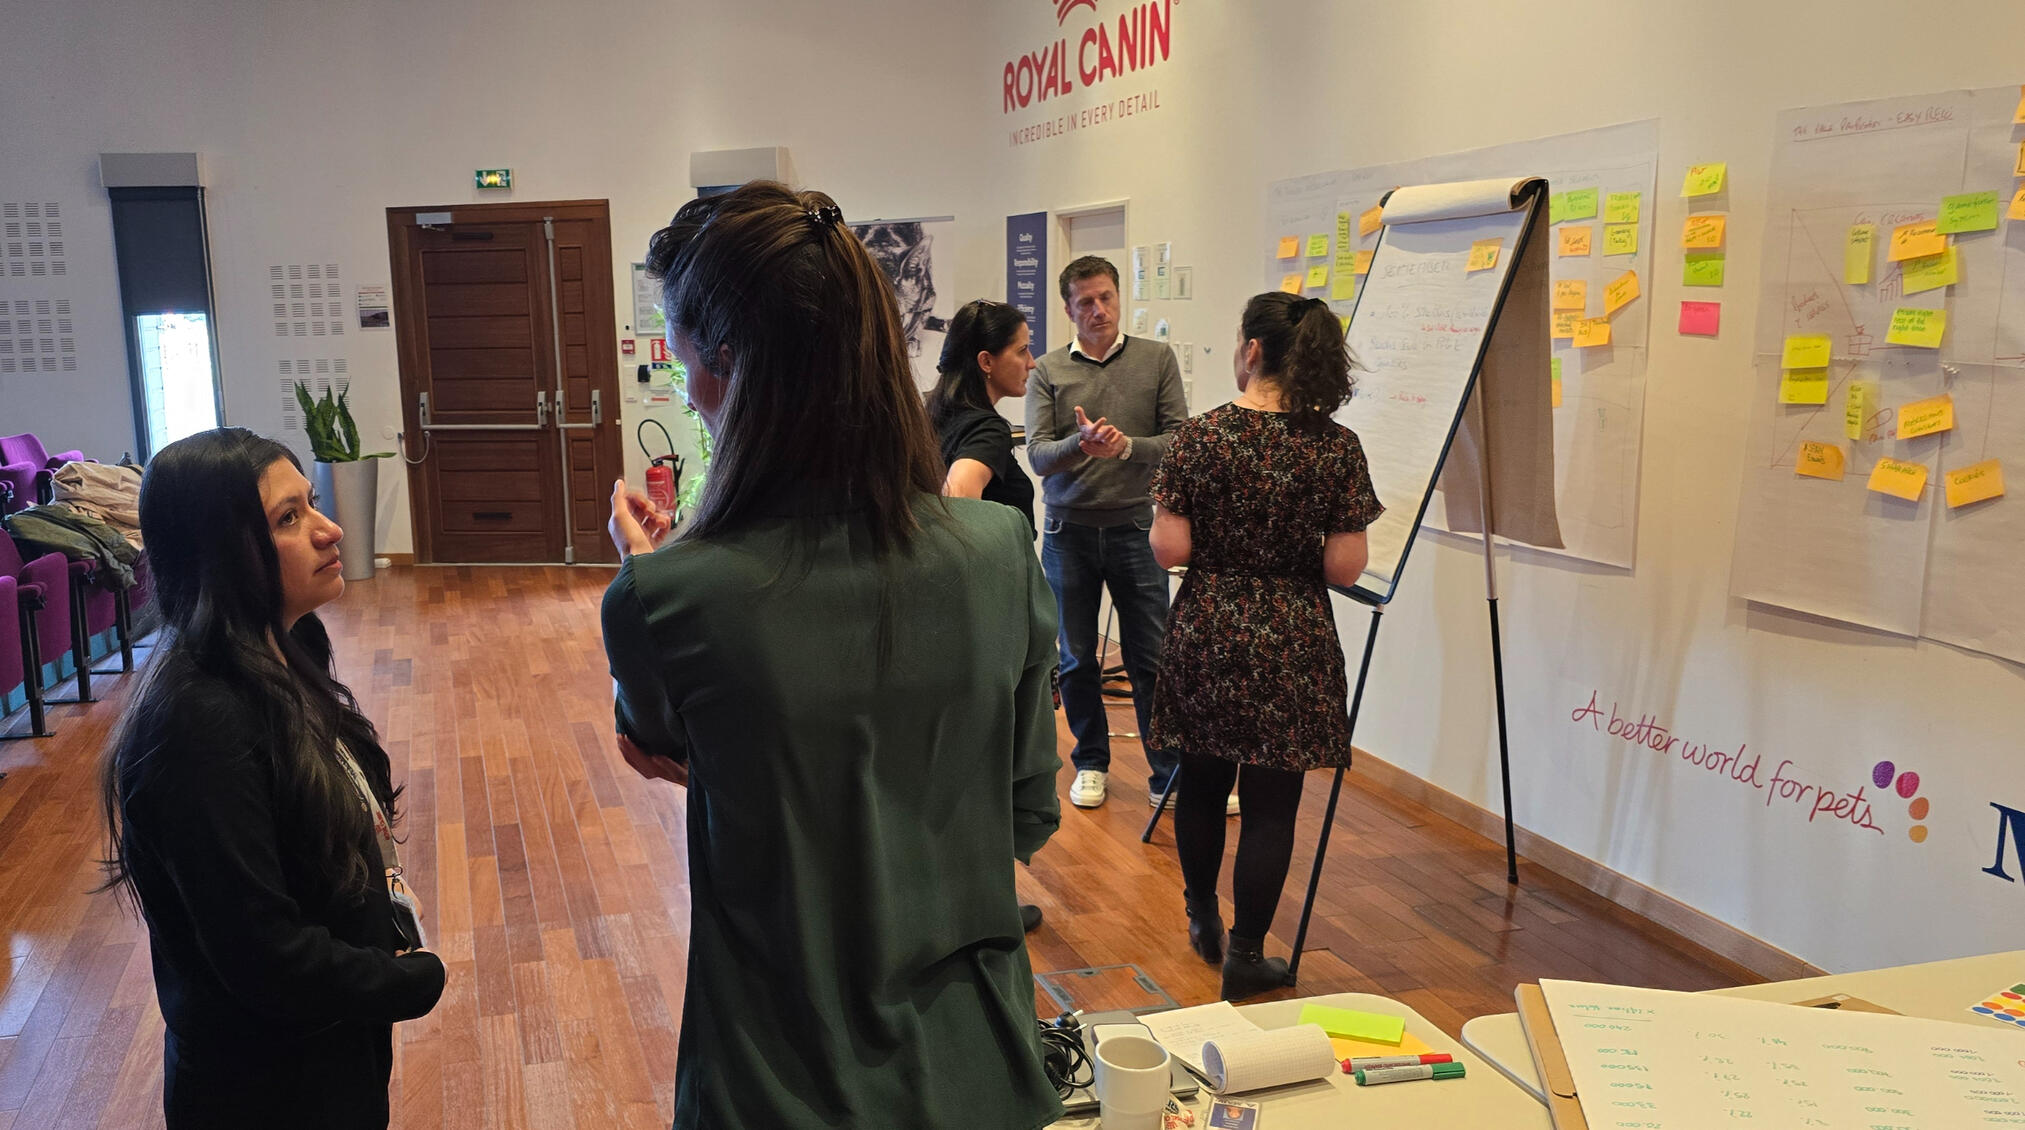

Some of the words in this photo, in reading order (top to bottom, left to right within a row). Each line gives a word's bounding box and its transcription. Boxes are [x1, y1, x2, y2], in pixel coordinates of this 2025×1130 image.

[1003, 38, 1072, 115] ROYAL
[1078, 0, 1170, 87] CANIN
[1008, 117, 1064, 148] INCREDIBLE
[1067, 112, 1077, 131] IN
[1081, 103, 1114, 129] EVERY
[1118, 90, 1160, 118] DETAIL
[1571, 689, 1604, 731] A
[1607, 702, 1679, 755] better
[1681, 741, 1763, 789] world
[1766, 760, 1813, 806] for
[1809, 785, 1885, 835] pets
